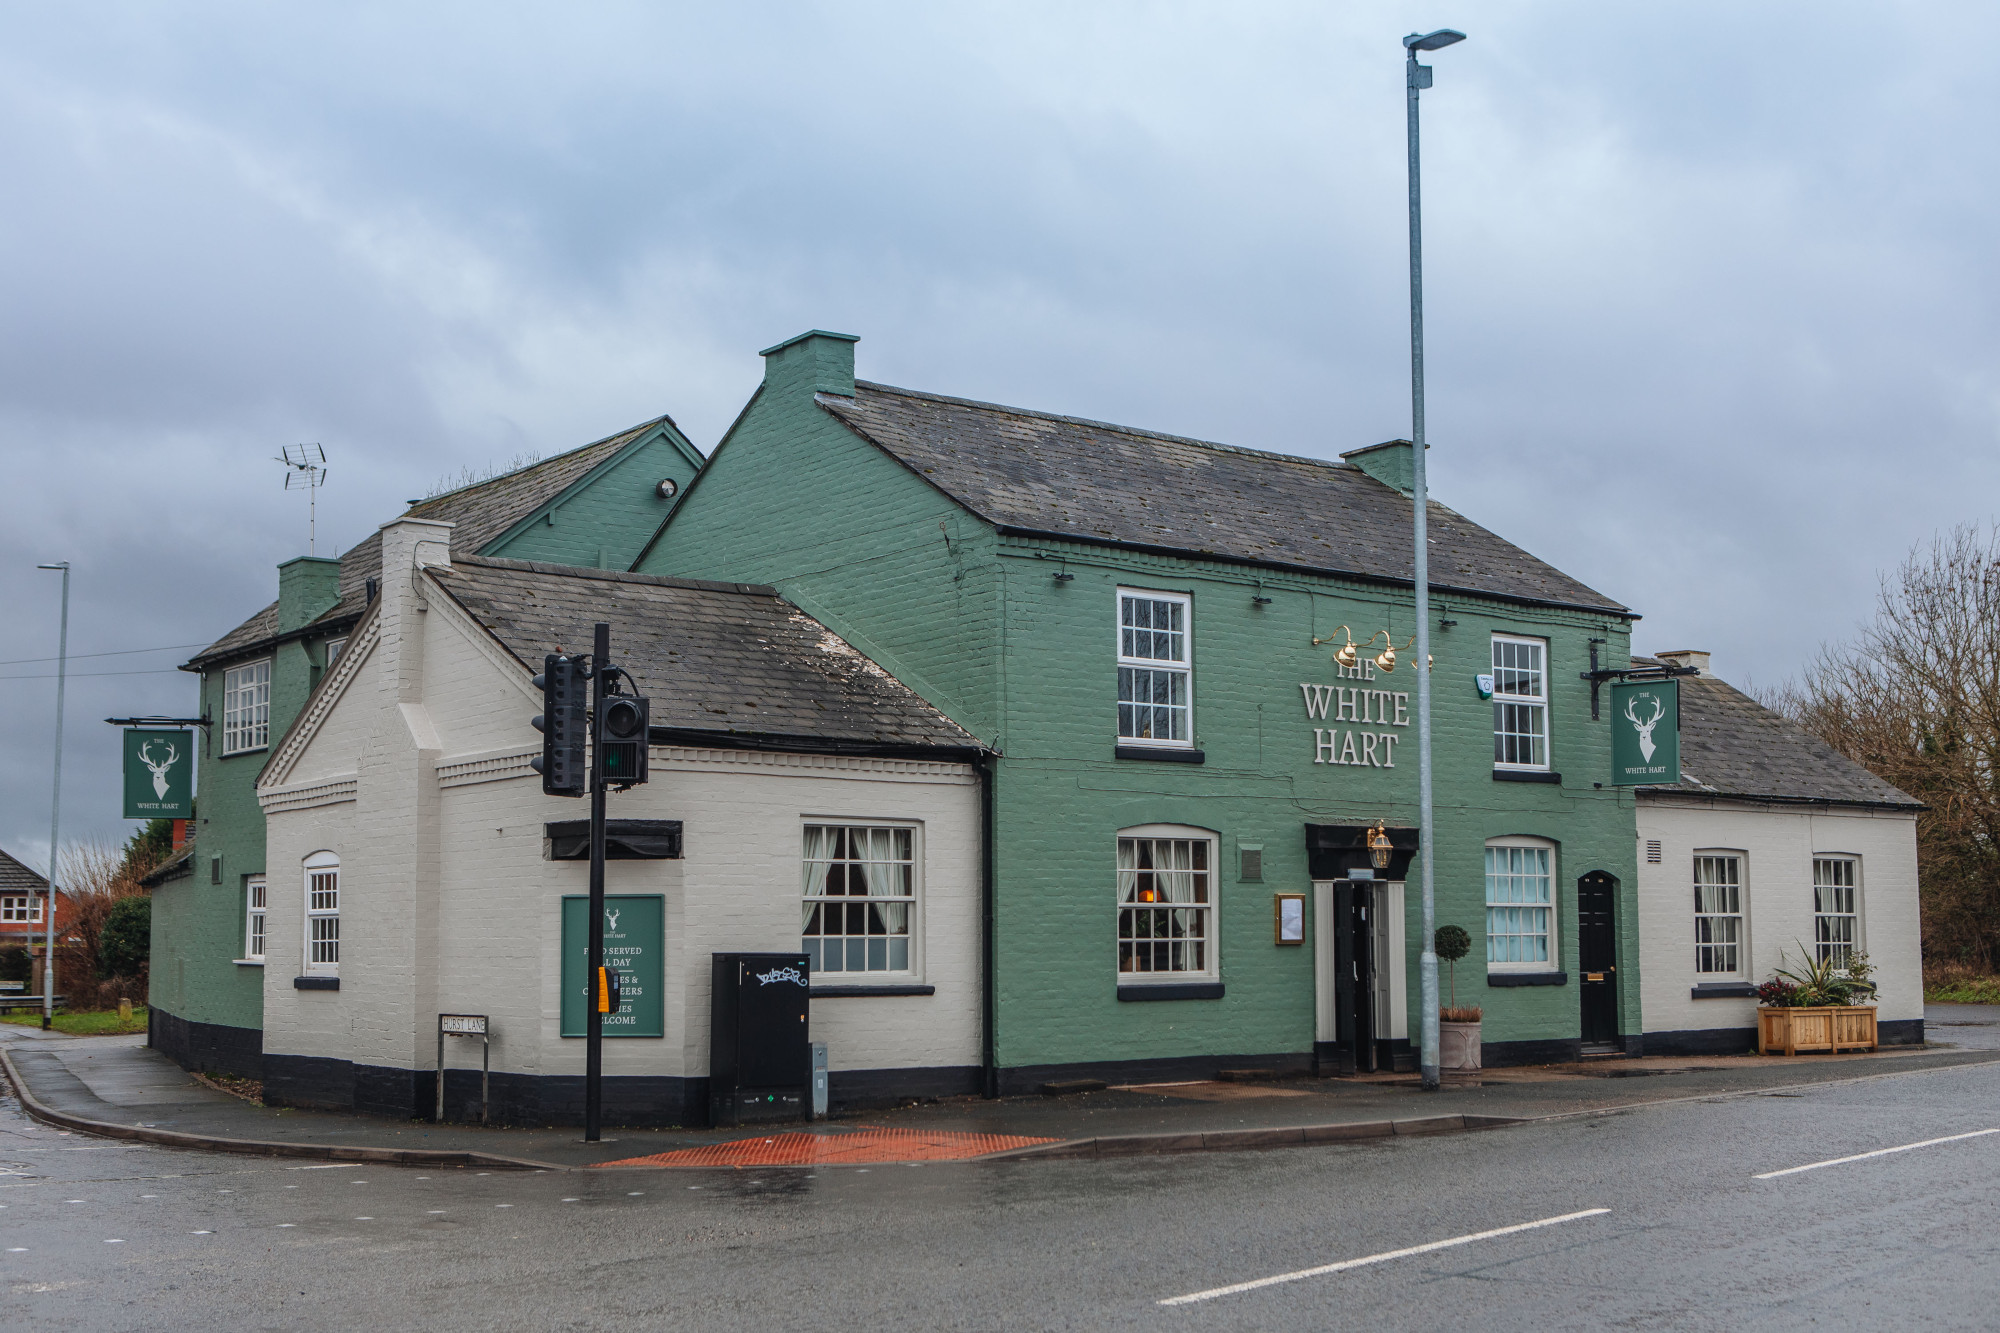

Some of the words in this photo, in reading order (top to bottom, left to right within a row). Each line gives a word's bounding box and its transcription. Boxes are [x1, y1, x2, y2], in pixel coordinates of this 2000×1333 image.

[1300, 683, 1410, 726] WHITE
[1314, 728, 1399, 768] HART
[1625, 767, 1647, 775] WHITE
[1648, 766, 1666, 774] HART
[609, 947, 642, 955] SERVED
[613, 958, 632, 966] DAY
[620, 987, 643, 995] EERS
[443, 1017, 464, 1030] HURST
[467, 1018, 485, 1031] LANE
